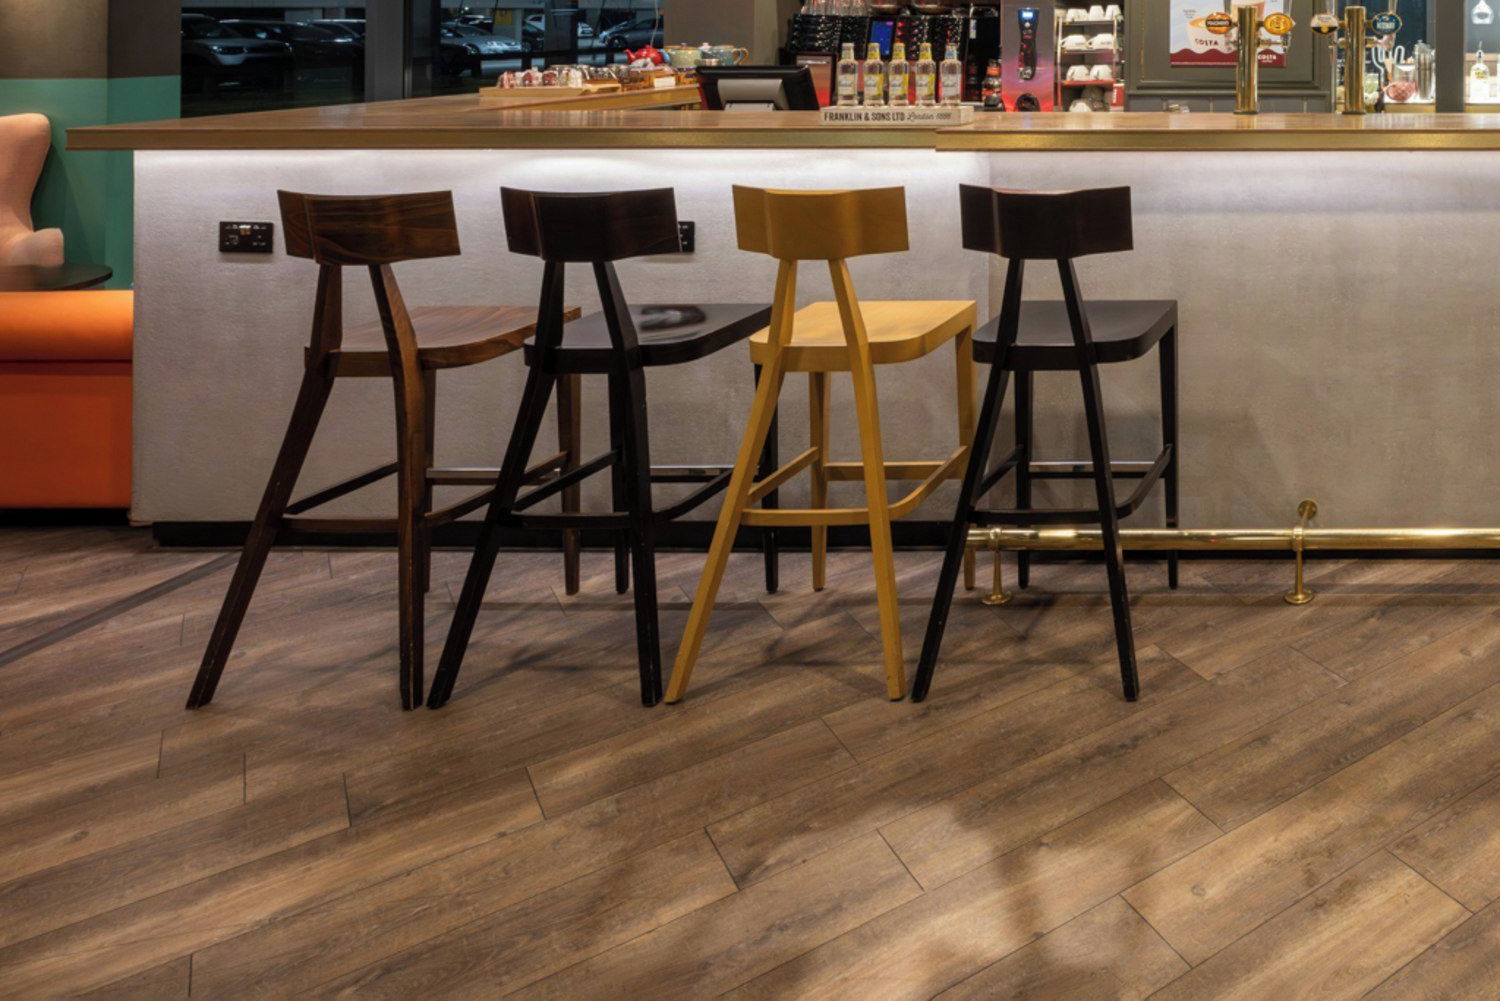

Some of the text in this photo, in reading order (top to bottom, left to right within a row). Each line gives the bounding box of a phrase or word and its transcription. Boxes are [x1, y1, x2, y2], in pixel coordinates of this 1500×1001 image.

[1194, 38, 1219, 47] COSTA
[824, 112, 862, 122] FRANKLIN
[863, 112, 871, 122] &
[871, 112, 891, 122] SONS
[892, 112, 906, 122] LTD
[906, 112, 935, 122] London
